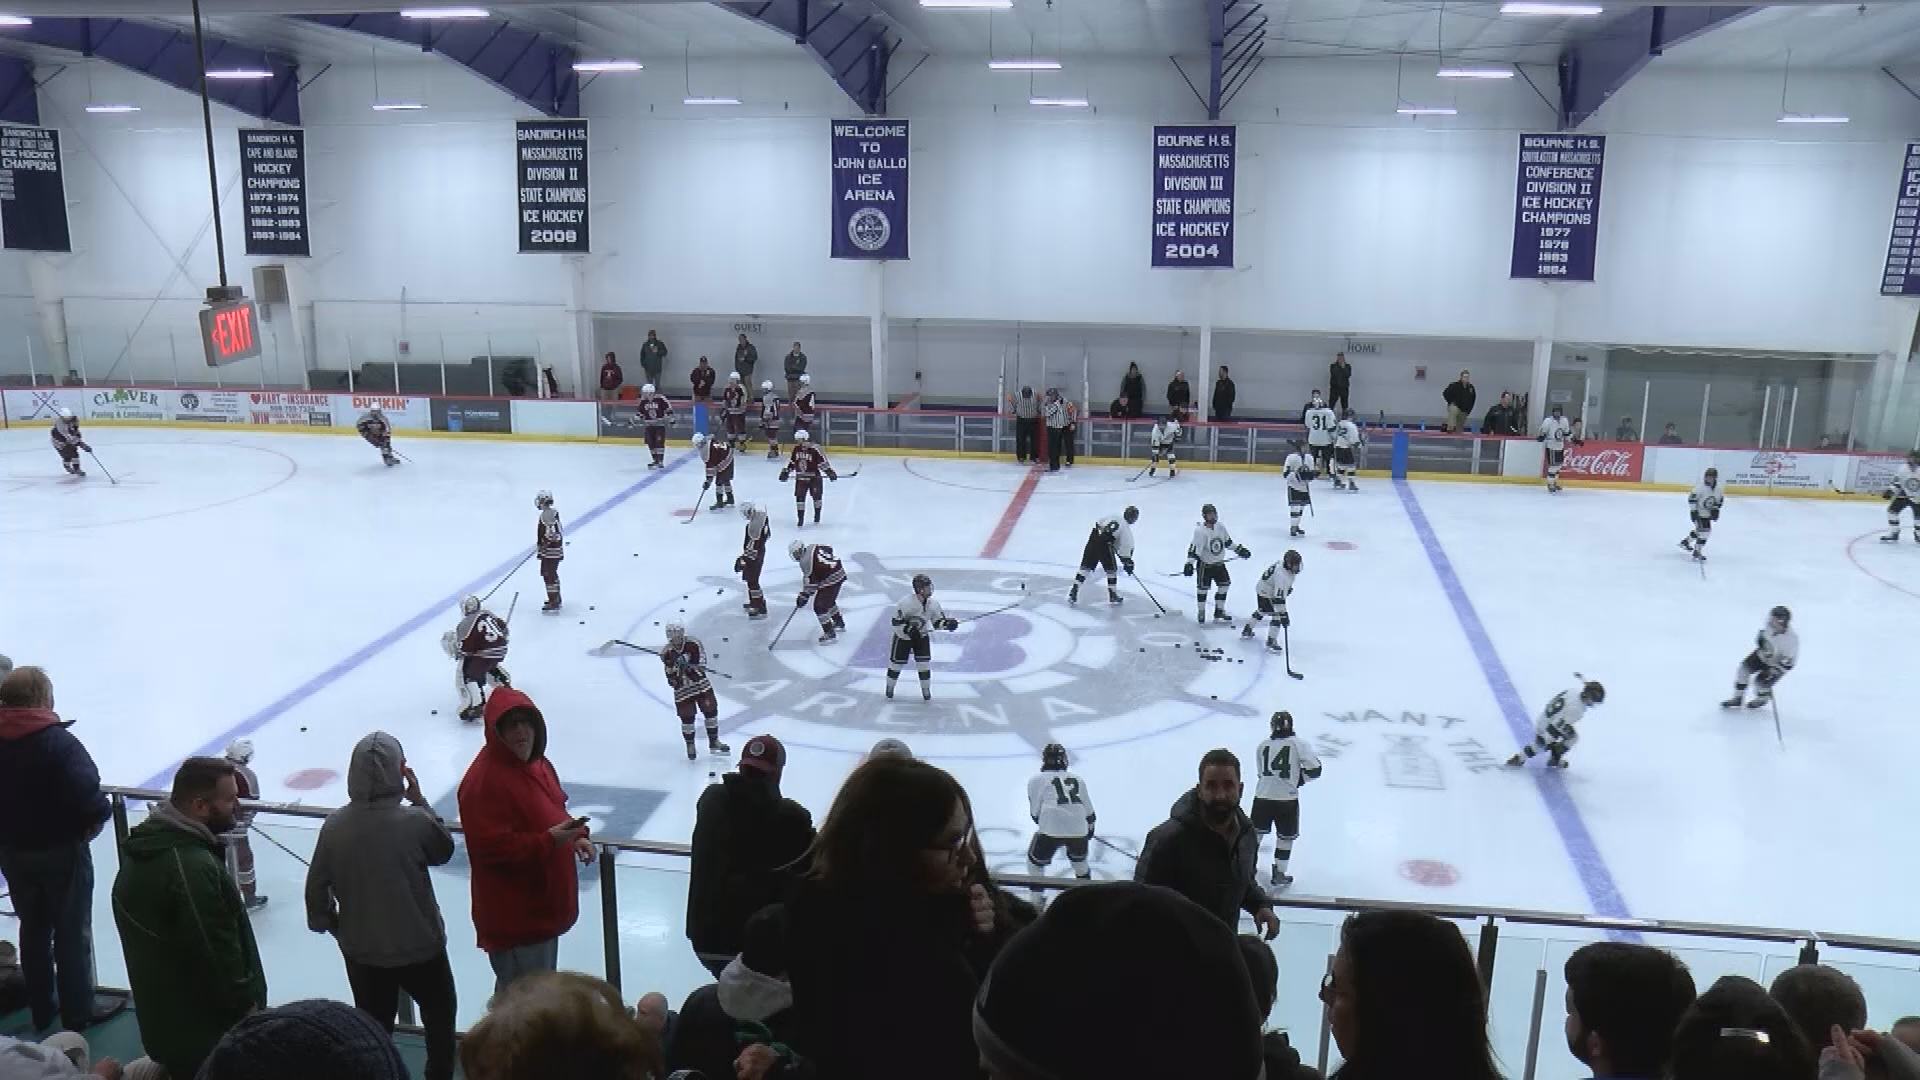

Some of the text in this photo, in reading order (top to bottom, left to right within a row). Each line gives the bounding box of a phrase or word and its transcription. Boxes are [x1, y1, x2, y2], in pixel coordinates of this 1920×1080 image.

[517, 128, 566, 141] SANDWICH
[834, 125, 907, 137] WELCOME
[860, 141, 881, 153] TO
[1157, 134, 1206, 147] BOURNE
[1524, 137, 1575, 149] BOURNE
[18, 149, 56, 160] HOCKEY
[521, 146, 583, 161] MASSACHUSETTS
[2, 158, 57, 172] CHAMPIONS
[833, 157, 907, 169] JOHN GALLO
[1158, 153, 1230, 169] MASSACHUSETTS
[253, 162, 292, 175] HOCKEY
[527, 167, 578, 181] DIVISION II
[1526, 165, 1595, 180] CONFERENCE
[247, 177, 301, 189] CHAMPIONS
[857, 173, 883, 185] ICE
[1164, 175, 1224, 191] DIVISION III
[520, 187, 587, 203] STATE CHAMPIONS
[844, 189, 896, 201] ARENA
[1526, 181, 1592, 195] DIVISION II
[1156, 197, 1231, 215] STATE CHAMPIONS
[1521, 196, 1594, 211] ICE HOCKEY
[522, 209, 584, 223] ICE HOCKEY
[1522, 211, 1592, 225] CHAMPIONS
[530, 229, 577, 243] 2008
[1156, 221, 1230, 237] ICE HOCKEY
[1165, 243, 1220, 259] 2004
[215, 307, 253, 357] EXIT
[733, 322, 762, 334] GUEST
[1347, 342, 1377, 354] HOME
[261, 392, 280, 405] HART
[287, 393, 329, 406] INSURANCE
[252, 411, 269, 425] WIN
[1311, 413, 1327, 430] 31
[732, 679, 1098, 727] ARENA
[1322, 709, 1467, 729] WANT
[1261, 744, 1292, 780] 14
[1050, 776, 1084, 806] 12
